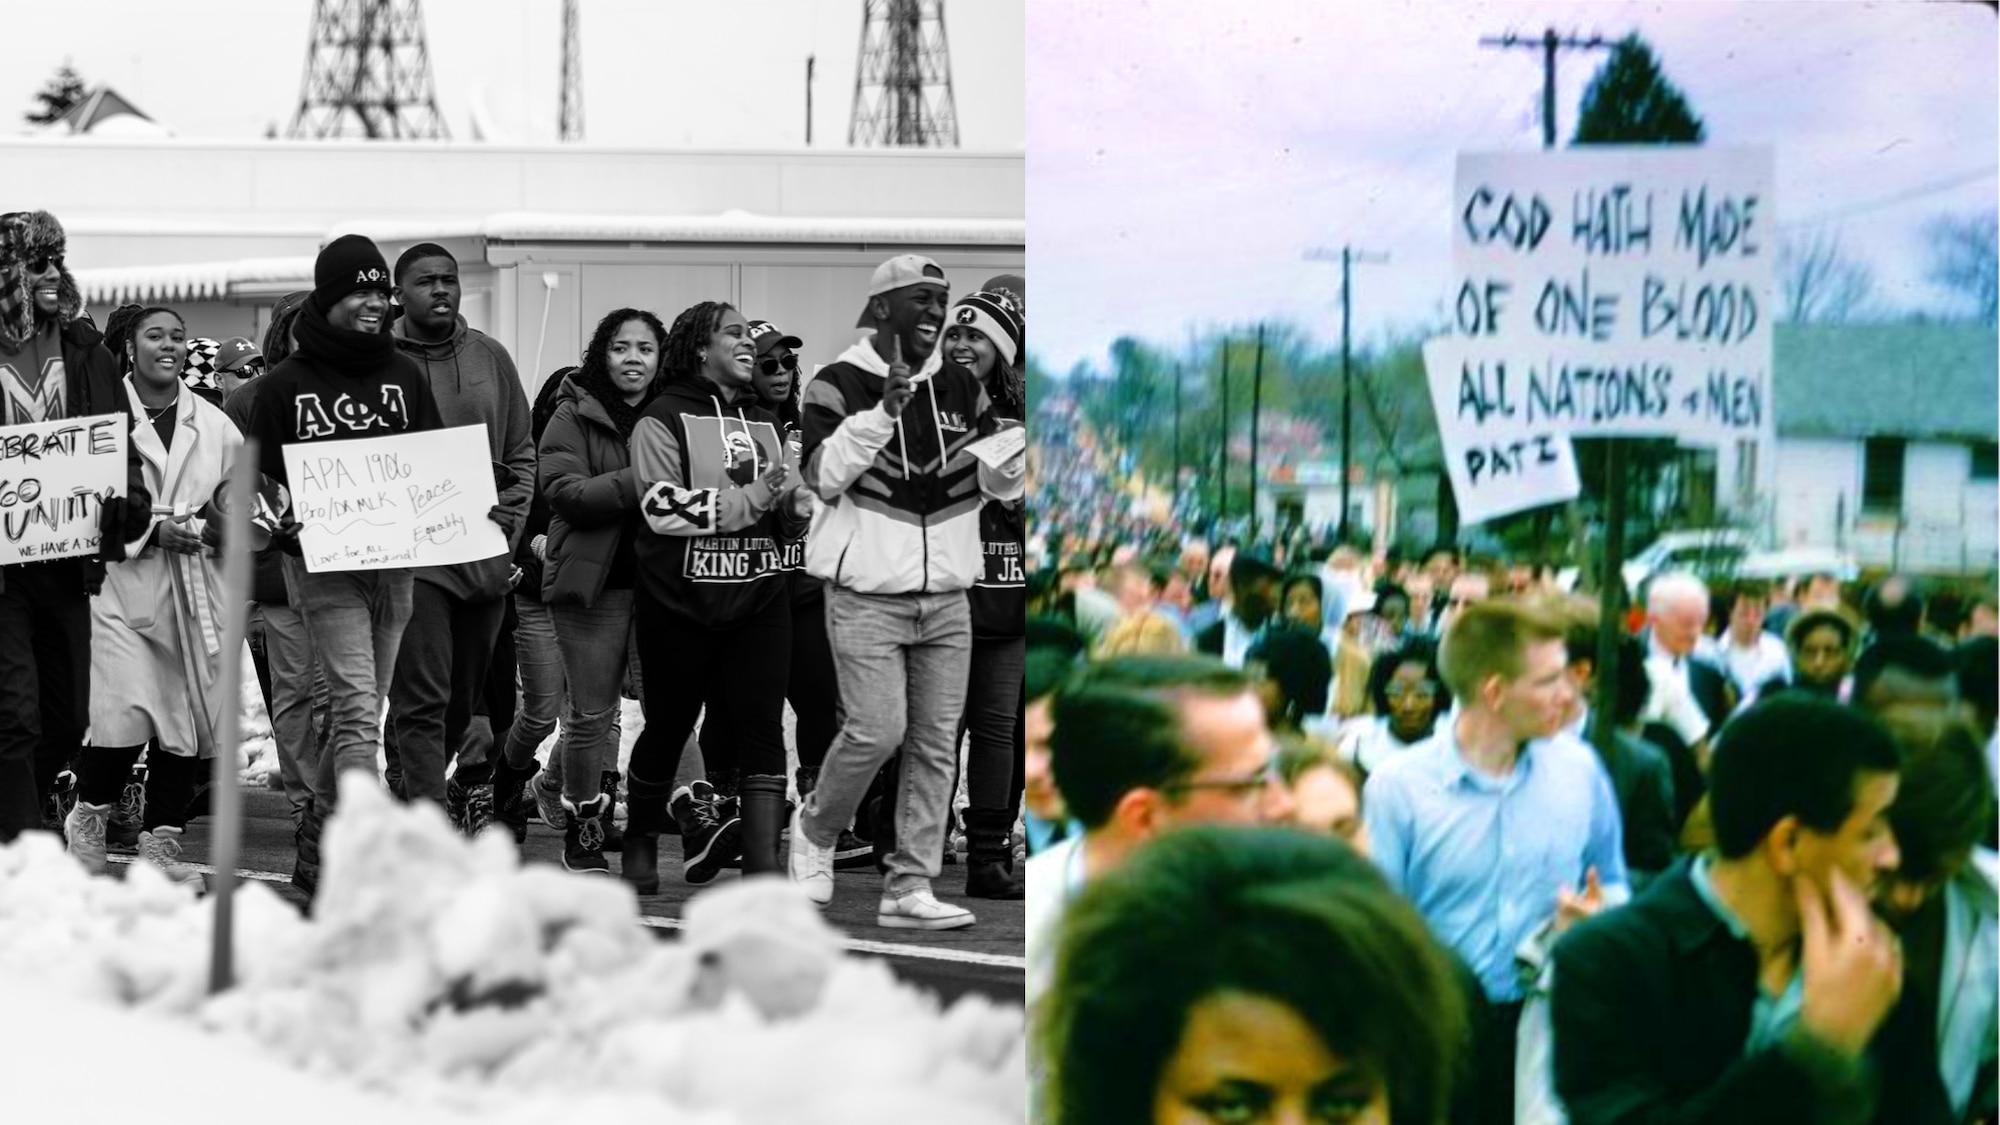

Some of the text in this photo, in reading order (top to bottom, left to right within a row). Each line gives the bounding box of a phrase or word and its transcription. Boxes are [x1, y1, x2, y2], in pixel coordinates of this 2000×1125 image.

[1573, 180, 1653, 255] HATH
[1675, 182, 1760, 270] MADE
[1456, 266, 1759, 344] OF ONE BLOOD
[1458, 360, 1515, 425] ALL
[1527, 358, 1672, 426] NATIONS
[1706, 367, 1765, 429] MEN
[0, 420, 118, 465] BRATE
[302, 453, 412, 494] APA 1906
[406, 478, 457, 514] Peace
[413, 512, 468, 543] Equality
[694, 538, 740, 550] MARTIN
[18, 545, 37, 557] WE
[41, 538, 70, 555] HAVE
[72, 538, 81, 550] A
[691, 551, 749, 577] KING
